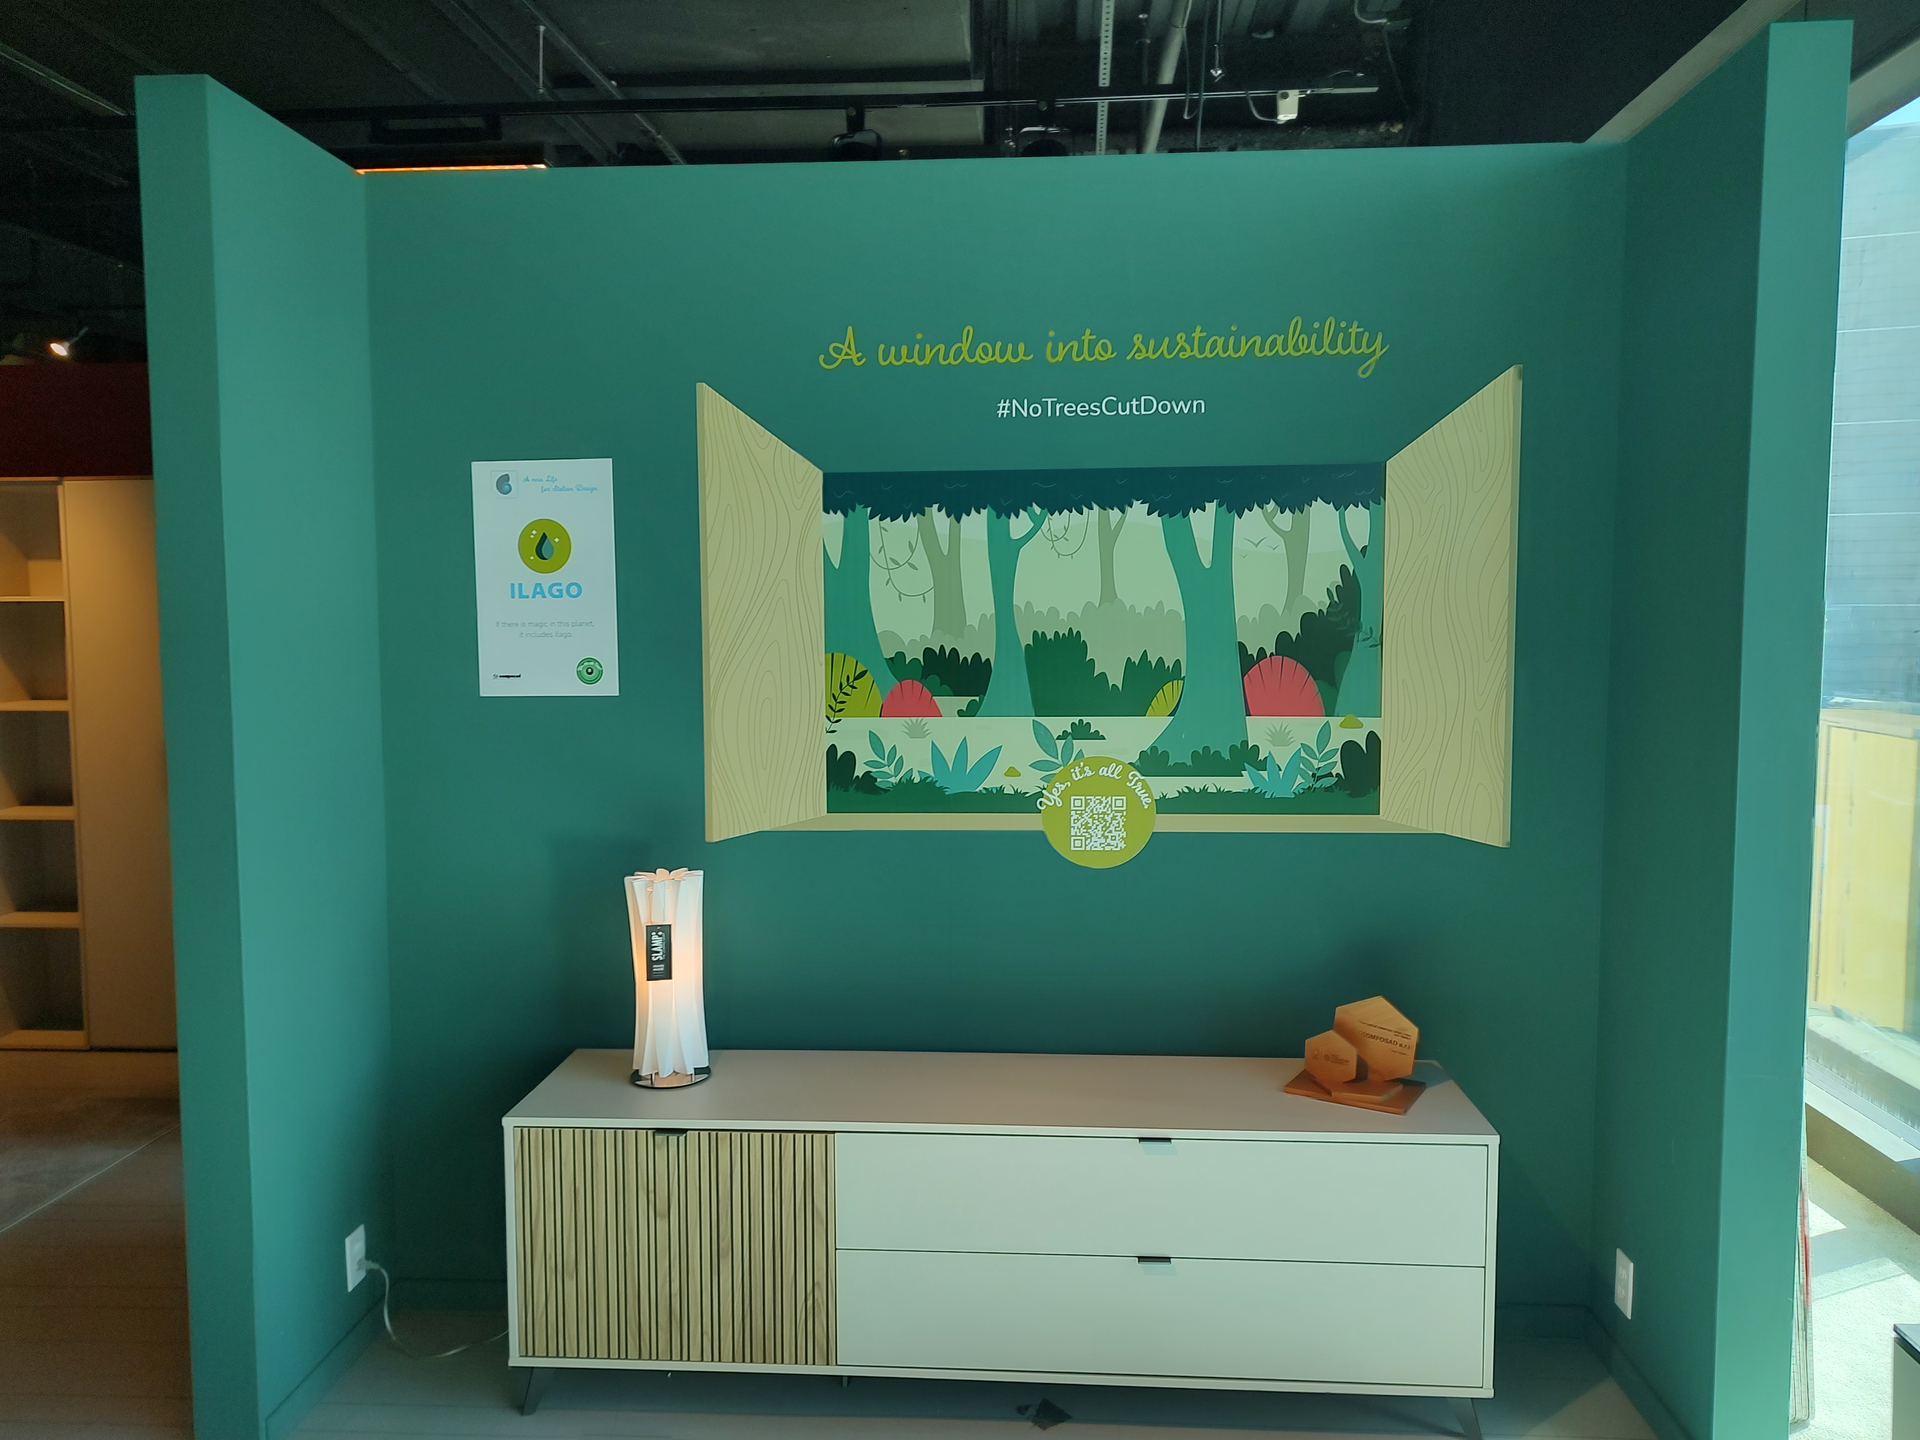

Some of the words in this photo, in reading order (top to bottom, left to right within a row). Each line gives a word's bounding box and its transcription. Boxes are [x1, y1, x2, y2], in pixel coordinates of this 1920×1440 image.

[819, 325, 867, 370] A
[877, 325, 1034, 366] window
[1045, 327, 1118, 364] into
[1126, 316, 1390, 379] sustainability
[996, 395, 1206, 419] #NoTreesCutDown
[575, 483, 598, 494] Design
[510, 582, 583, 599] ILAGO
[527, 621, 548, 629] magic
[1036, 780, 1071, 810] Yes,
[1070, 761, 1095, 781] it's
[1098, 762, 1124, 780] all
